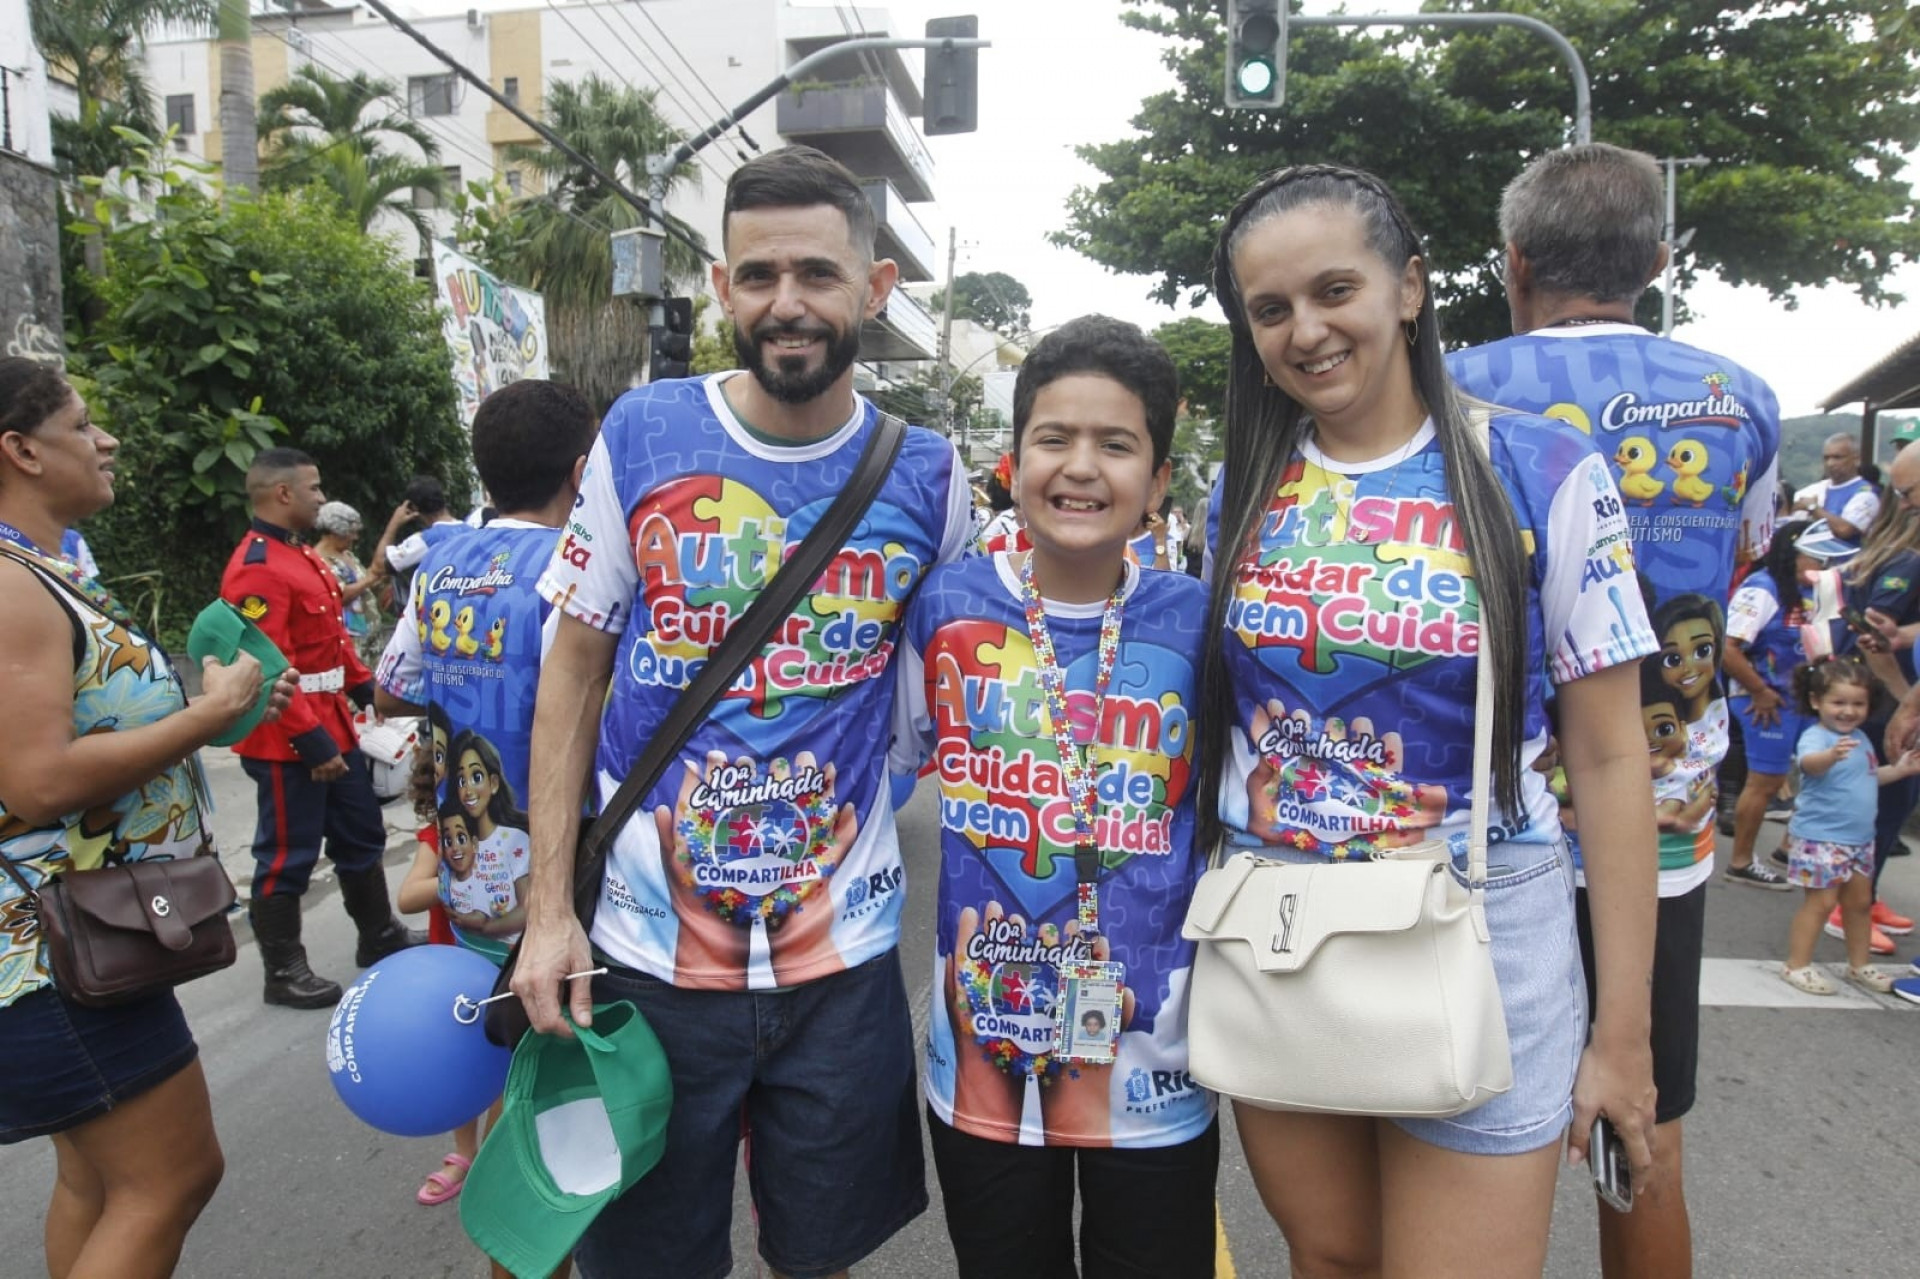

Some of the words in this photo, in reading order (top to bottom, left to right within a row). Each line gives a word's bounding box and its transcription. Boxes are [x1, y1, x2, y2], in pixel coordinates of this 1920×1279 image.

[1592, 495, 1621, 522] Rio
[1383, 556, 1467, 605] de
[651, 596, 814, 649] Cuir
[820, 609, 882, 653] de
[690, 768, 825, 812] Caminhada
[937, 736, 1070, 800] Cuida
[1096, 758, 1154, 808] de
[1278, 802, 1399, 833] COMPARTILHA
[696, 861, 818, 884] COMPARTILHA
[343, 970, 381, 1084] COMPARTILHA
[976, 1014, 1053, 1042] COMPART
